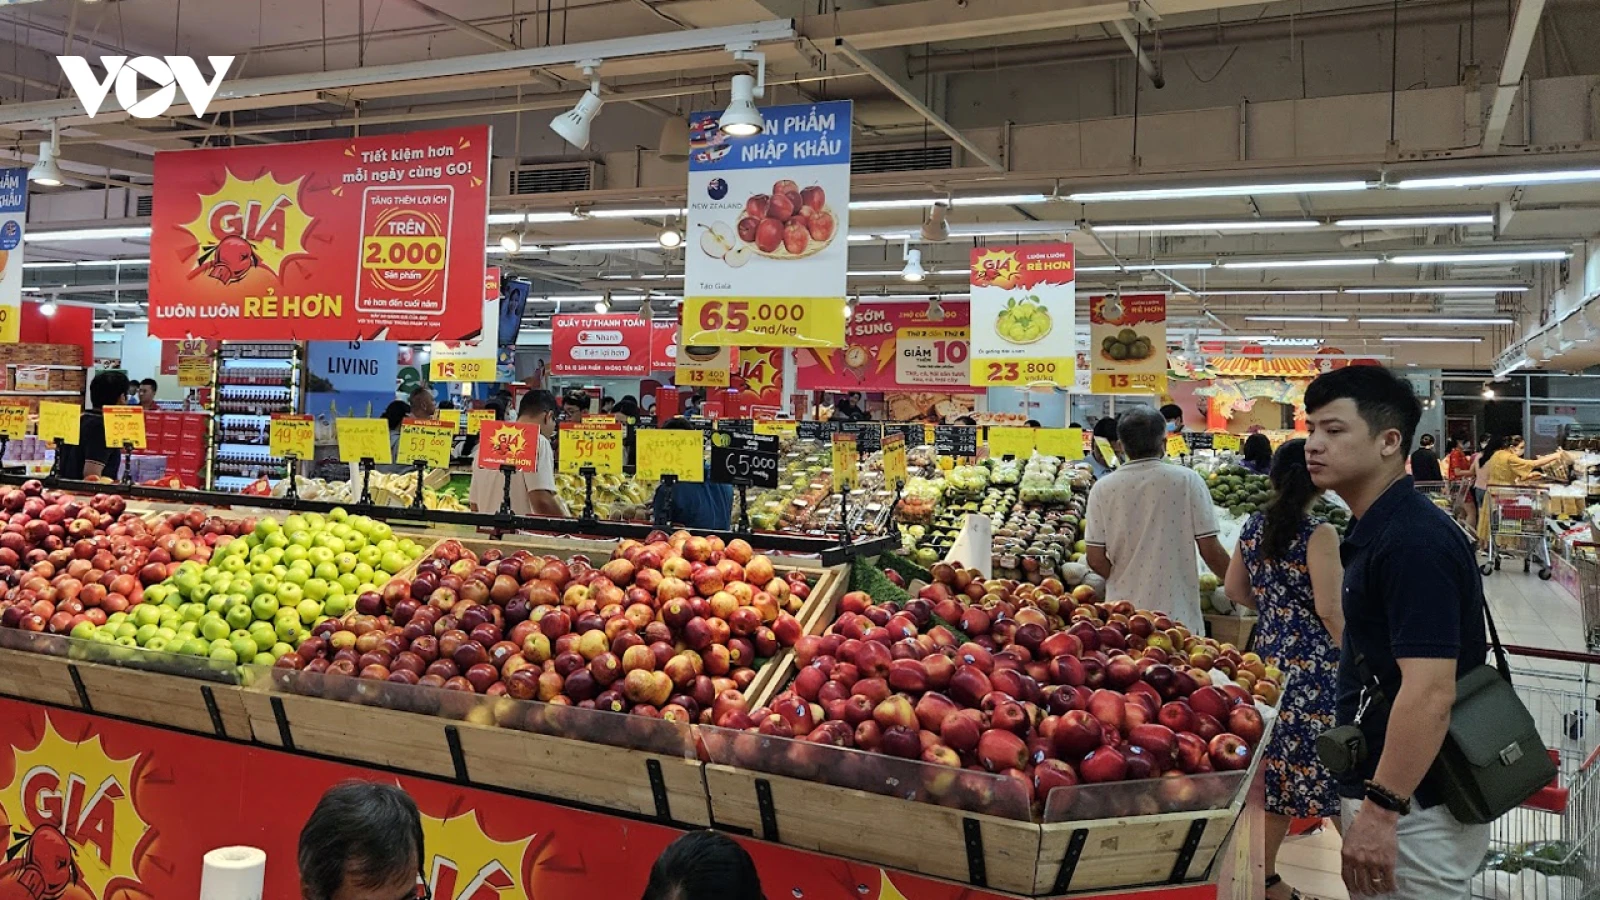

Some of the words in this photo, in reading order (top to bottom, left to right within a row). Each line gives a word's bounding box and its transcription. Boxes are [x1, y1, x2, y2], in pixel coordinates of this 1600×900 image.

[784, 107, 835, 134] PHẨM
[361, 148, 388, 163] Tiết
[391, 148, 424, 162] kiệm
[428, 145, 454, 157] hơn
[741, 139, 788, 164] NHẬP
[794, 130, 841, 159] KHẨU
[343, 168, 368, 182] mỗi
[372, 168, 404, 181] ngày
[409, 165, 442, 178] cùng
[446, 161, 472, 175] GO!
[0, 189, 21, 206] HẨU
[207, 194, 293, 250] GIÁ
[388, 219, 425, 235] TRÊN
[366, 242, 442, 264] 2.000
[982, 257, 1012, 271] GIÁ
[1026, 260, 1043, 271] RẺ
[1044, 260, 1071, 271] HƠN
[156, 302, 196, 318] LUÔN
[201, 301, 240, 317] LUÔN
[244, 288, 277, 318] RẺ
[282, 293, 342, 318] HƠN
[594, 319, 621, 327] THANH
[623, 318, 646, 327] TOÁN
[855, 309, 885, 323] SỚM
[595, 333, 618, 341] Nhanh
[753, 323, 797, 336] vnd/kg
[855, 322, 893, 336] SUNG
[904, 346, 931, 357] GIẢM
[328, 357, 378, 375] LIVING
[742, 359, 767, 384] IÁ
[575, 440, 593, 459] 59
[597, 441, 616, 450] 000
[21, 765, 125, 868] GIÁ
